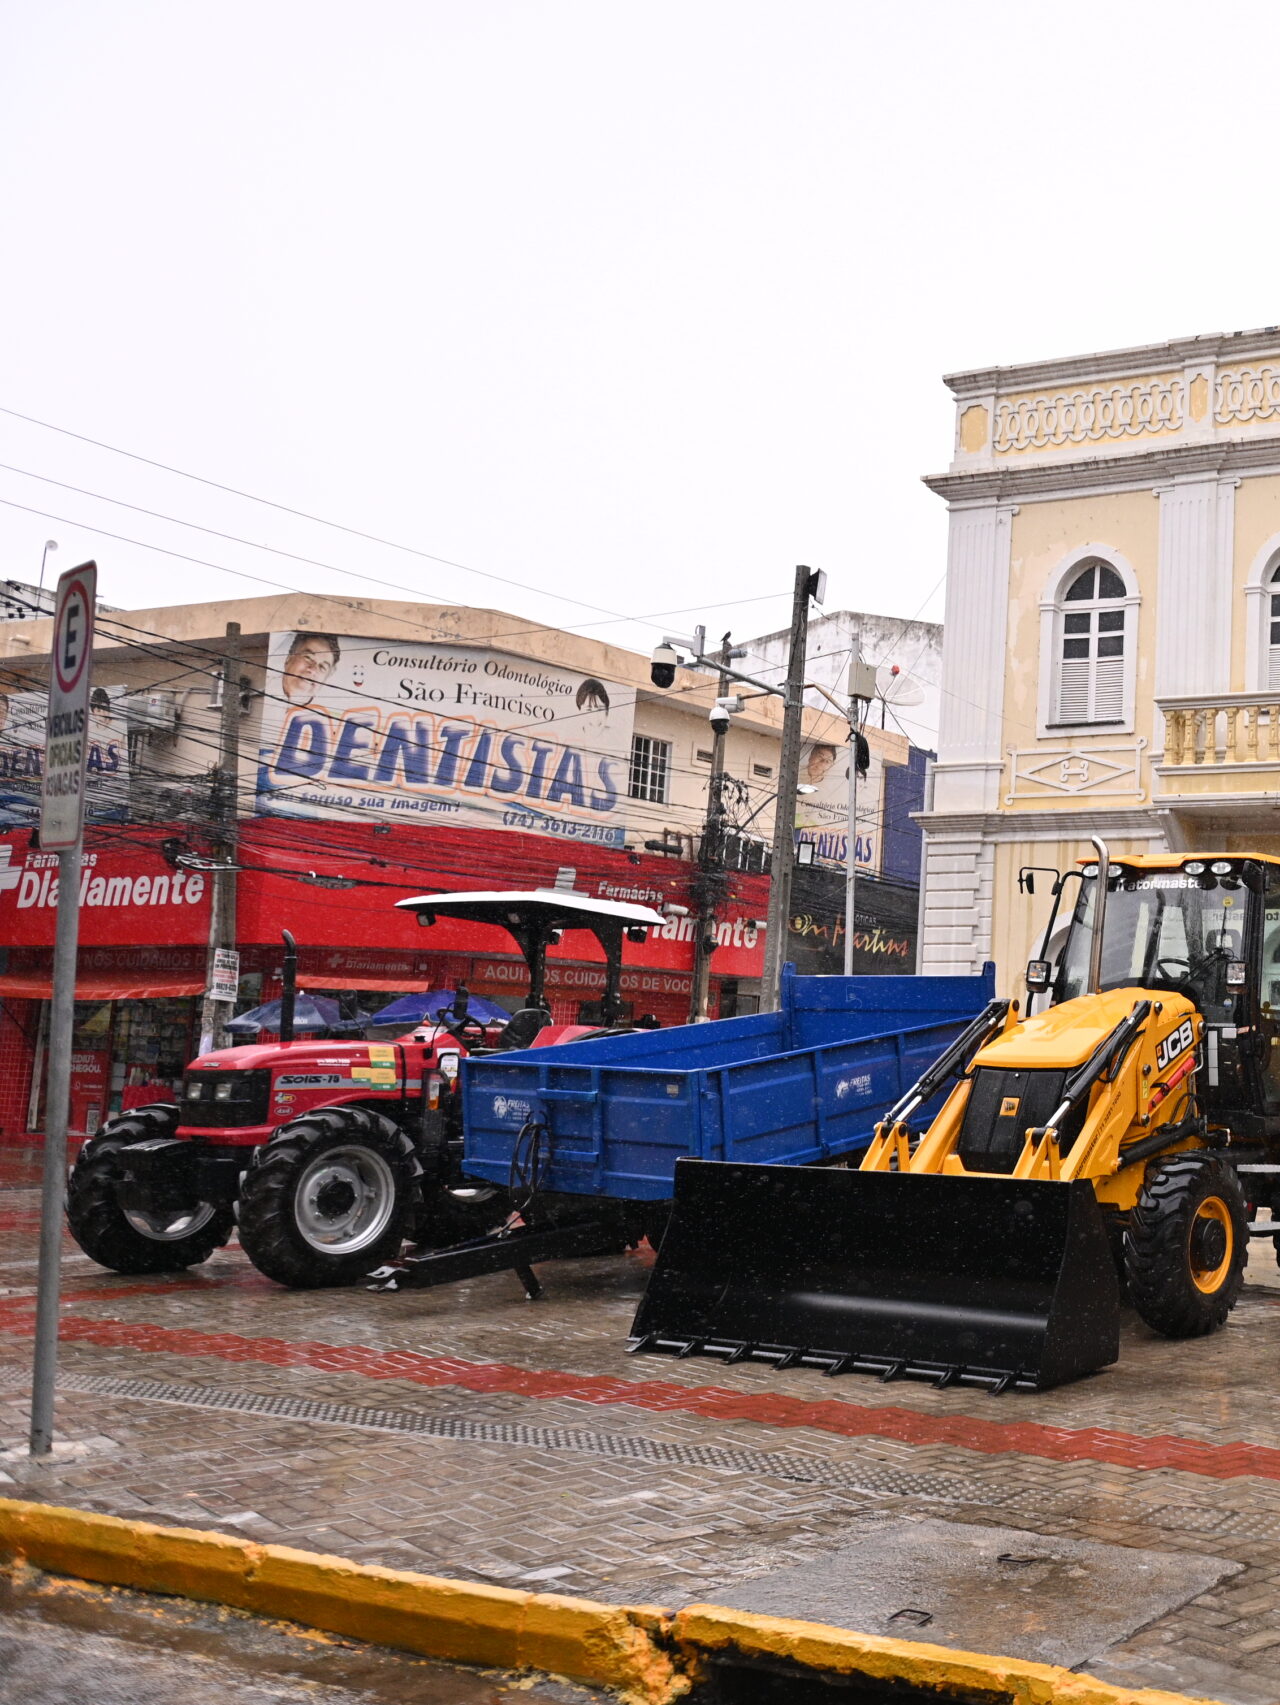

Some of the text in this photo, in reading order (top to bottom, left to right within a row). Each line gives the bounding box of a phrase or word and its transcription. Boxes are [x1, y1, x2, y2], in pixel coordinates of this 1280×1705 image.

[63, 604, 80, 670] E
[373, 650, 574, 696] Consultório Odontológico
[398, 678, 556, 722] São Francisco
[273, 714, 622, 813] DENTISTAS
[358, 796, 385, 809] sua
[836, 803, 875, 815] Odoológico
[503, 811, 534, 829] (74)
[25, 851, 98, 870] Farmas
[801, 830, 873, 863] NTISAS
[17, 869, 205, 909] Diaiamente
[598, 880, 664, 903] Farmácias
[484, 964, 524, 981] AQUI
[564, 970, 639, 988] CUIDAOS
[642, 976, 659, 988] DE
[663, 978, 694, 993] VOC
[1157, 1020, 1193, 1069] JCB
